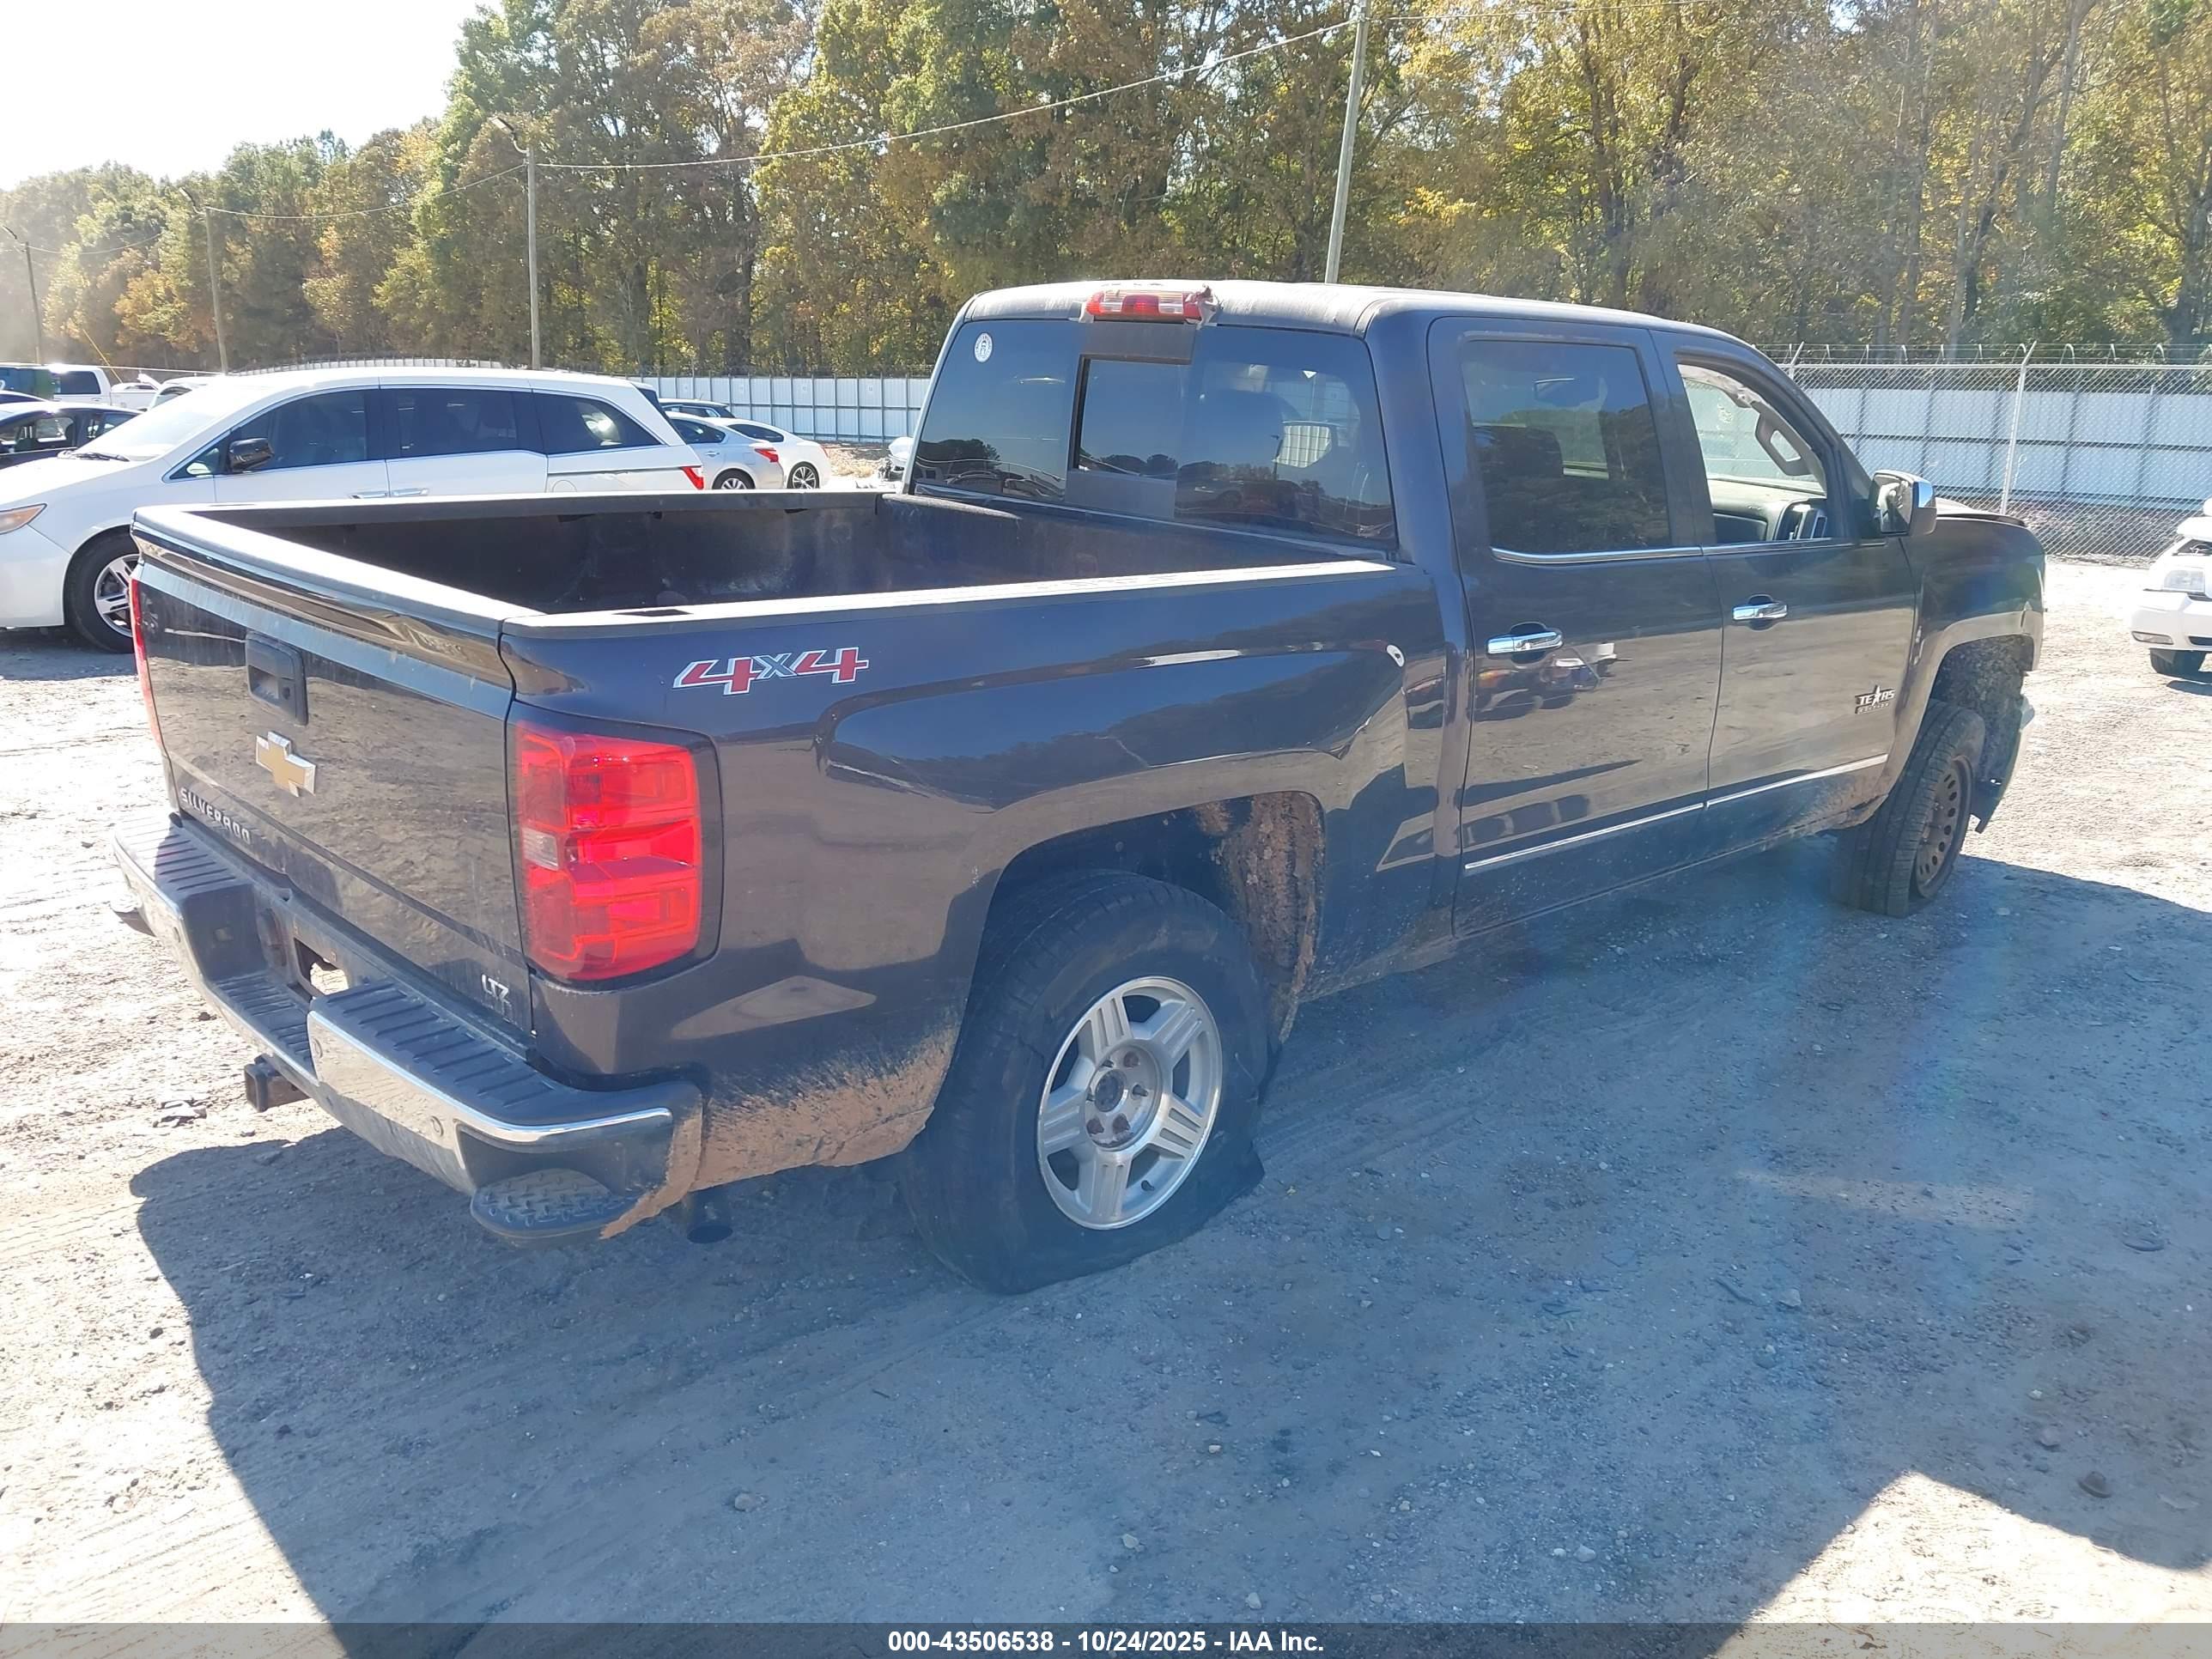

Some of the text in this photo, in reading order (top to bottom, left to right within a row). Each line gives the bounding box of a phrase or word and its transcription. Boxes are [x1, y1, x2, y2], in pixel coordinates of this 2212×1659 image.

[1858, 686, 1895, 706] TEXAS
[180, 787, 251, 845] SILVERADO
[481, 974, 510, 1004] LTZ
